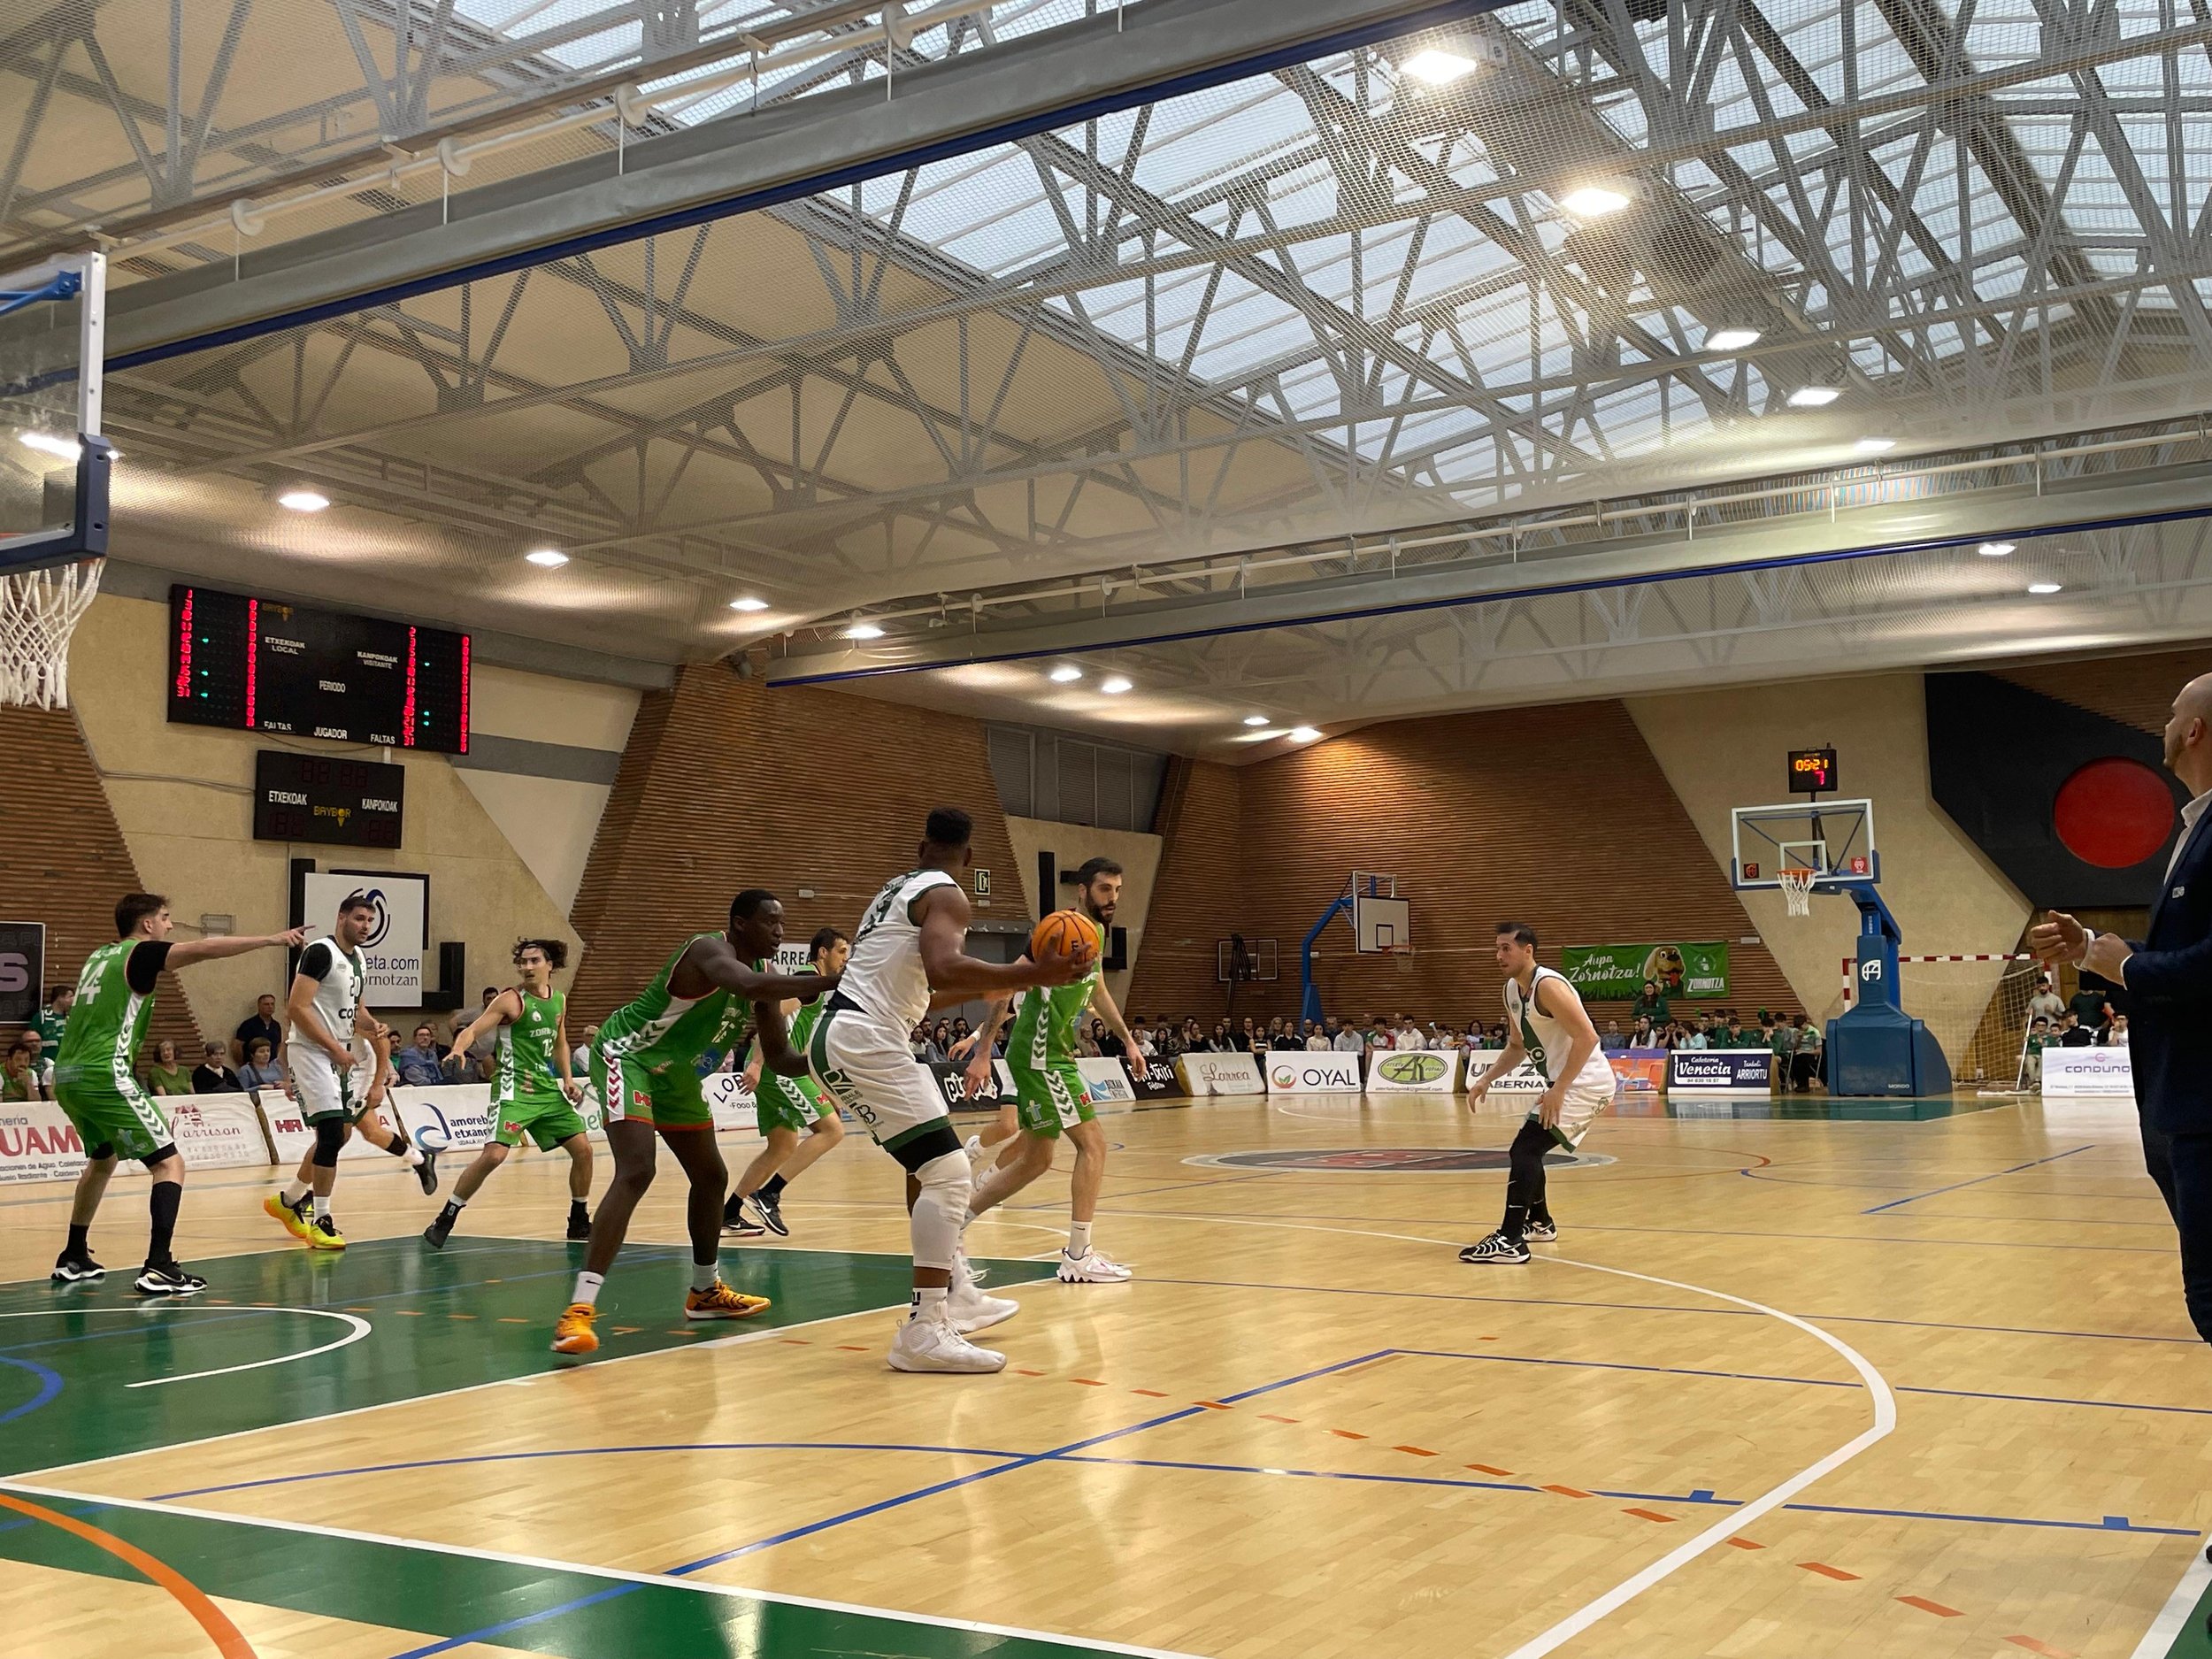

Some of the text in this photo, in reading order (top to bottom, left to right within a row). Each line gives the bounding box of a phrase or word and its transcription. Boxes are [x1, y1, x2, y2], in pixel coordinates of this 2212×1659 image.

[265, 636, 305, 649] ETXEKOAK
[272, 645, 299, 655] LOCAL
[357, 651, 398, 663] KANPOKOAK
[363, 659, 393, 669] VISITANTE
[319, 680, 346, 693] PERIODO
[264, 721, 292, 731] FALTAS
[313, 726, 348, 739] JUGADOR
[370, 733, 396, 744] FALTAS
[1815, 771, 1824, 785] 7
[268, 790, 308, 805] ETXEKOAK
[361, 798, 398, 812] KANPOKOAK
[1582, 953, 1614, 968] Aupa
[1569, 963, 1640, 983] Zornotza!
[363, 973, 419, 987] ornotzan
[1687, 978, 1724, 991] ZORNOTZA
[1200, 1062, 1251, 1082] Larrea
[1679, 1062, 1732, 1075] Venecia
[1736, 1069, 1768, 1079] ARRIORTU
[1303, 1069, 1356, 1087] OYAL
